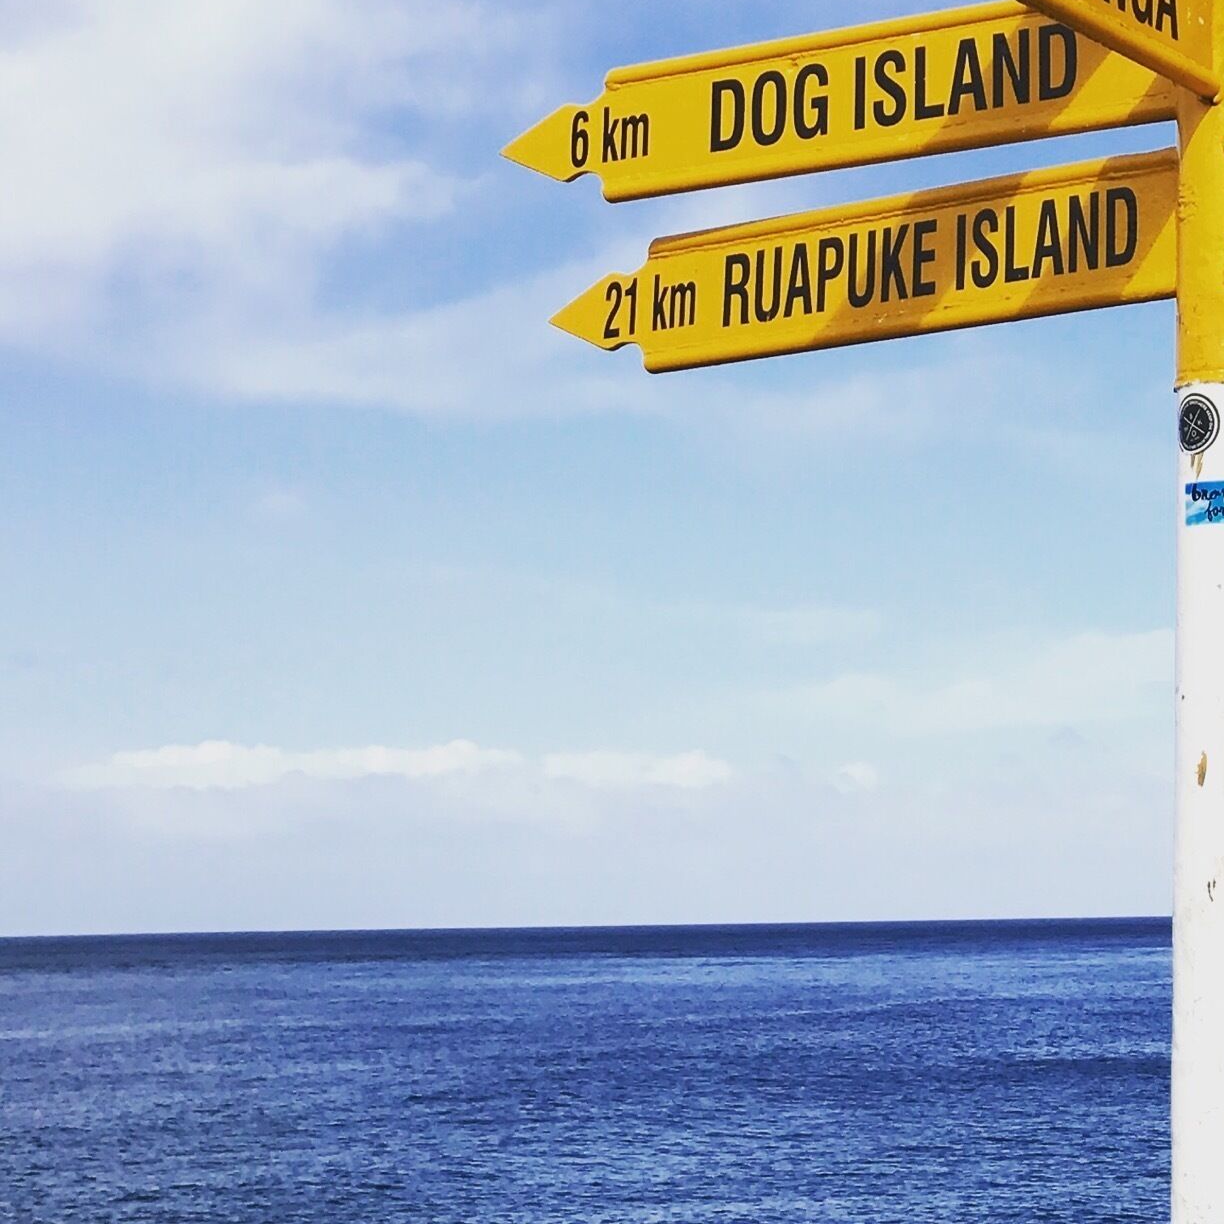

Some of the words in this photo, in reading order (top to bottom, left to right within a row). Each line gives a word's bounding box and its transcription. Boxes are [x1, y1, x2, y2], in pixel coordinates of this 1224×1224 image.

[571, 112, 589, 168] 6
[602, 107, 649, 163] km
[709, 63, 829, 153] DOG
[854, 23, 1078, 130] ISLAND
[603, 281, 637, 339] 21
[652, 275, 696, 330] km
[721, 220, 938, 328] RUAPUKE
[955, 186, 1138, 289] ISLAND
